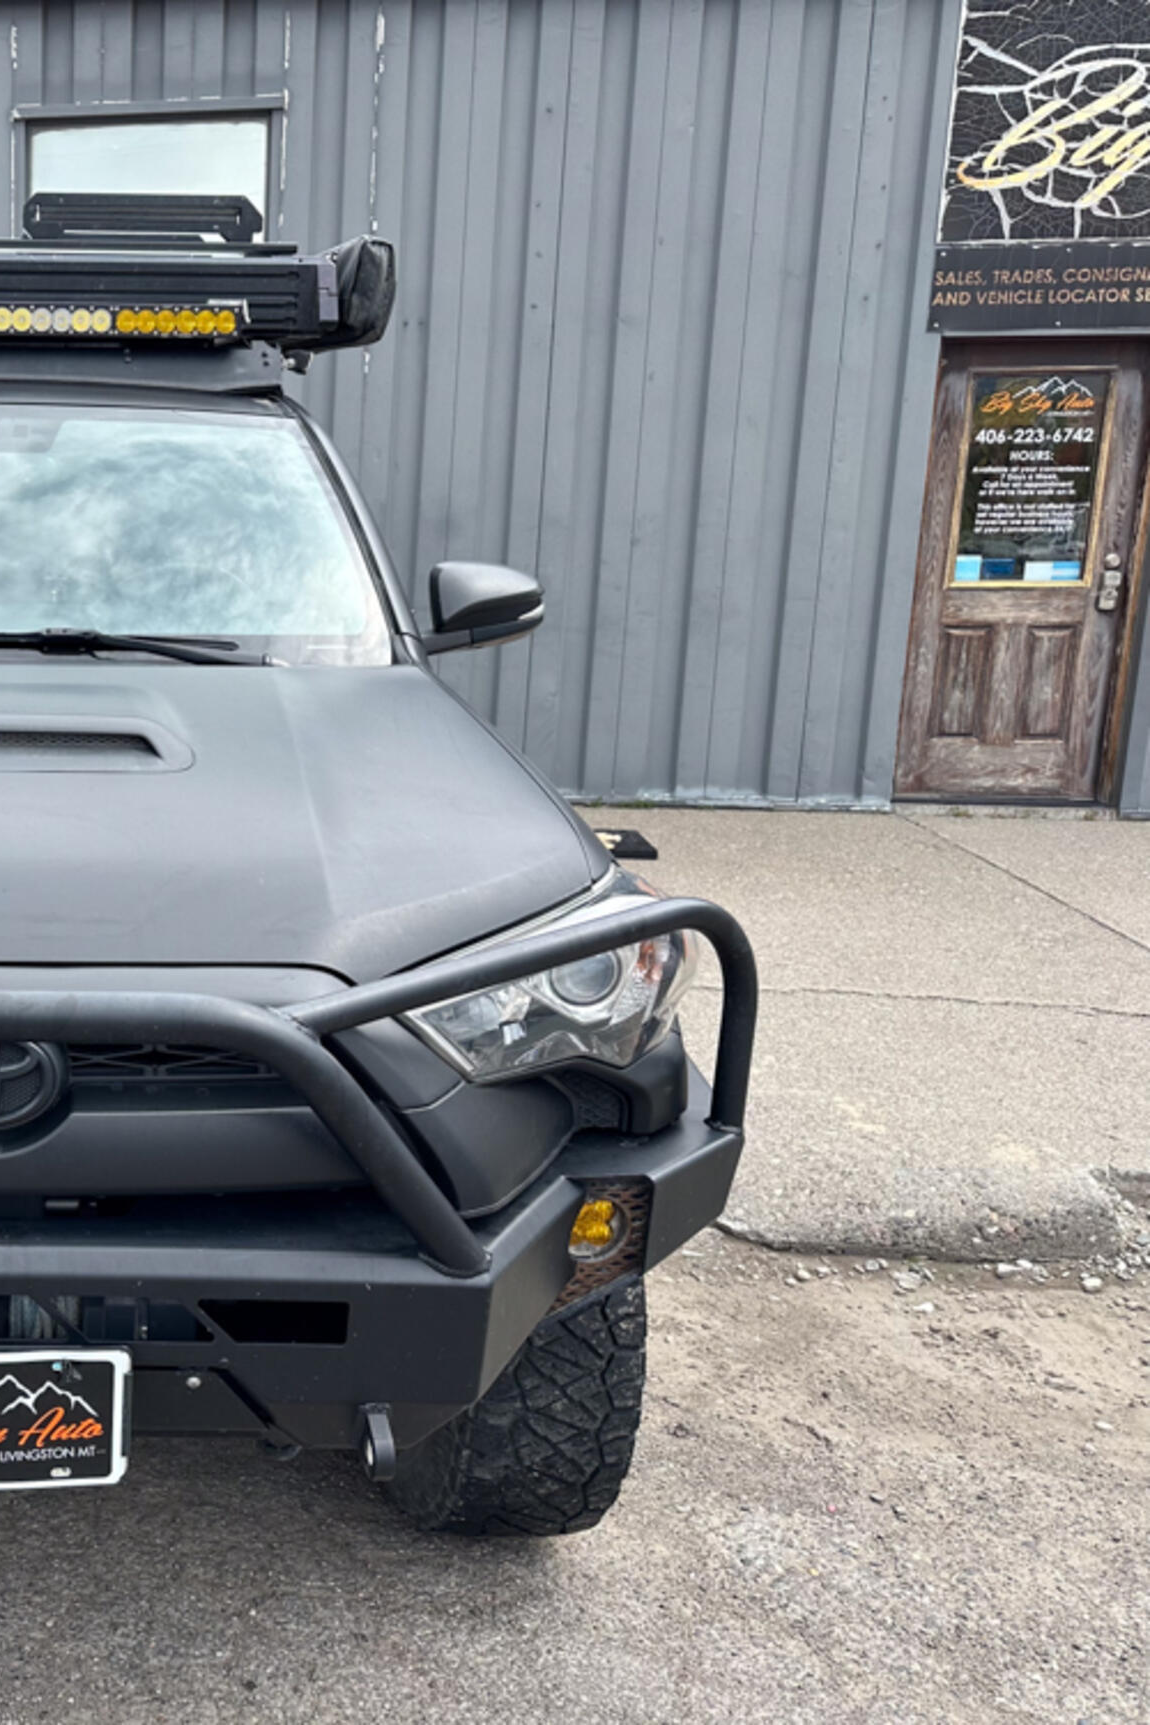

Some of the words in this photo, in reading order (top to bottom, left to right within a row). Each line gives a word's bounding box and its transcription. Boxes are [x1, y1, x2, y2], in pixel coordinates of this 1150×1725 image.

[934, 269, 987, 286] SALES,
[993, 268, 1057, 285] TRADES,
[1063, 267, 1150, 282] CONSIGN
[932, 291, 971, 306] AND
[976, 289, 1044, 305] VEHICLE
[1049, 287, 1130, 303] LOCATOR
[975, 427, 1094, 444] 406-223-6742
[1010, 450, 1054, 461] HOURS:
[18, 1407, 104, 1447] Auto
[0, 1448, 75, 1464] LIVINGSTON
[77, 1446, 96, 1458] MT
